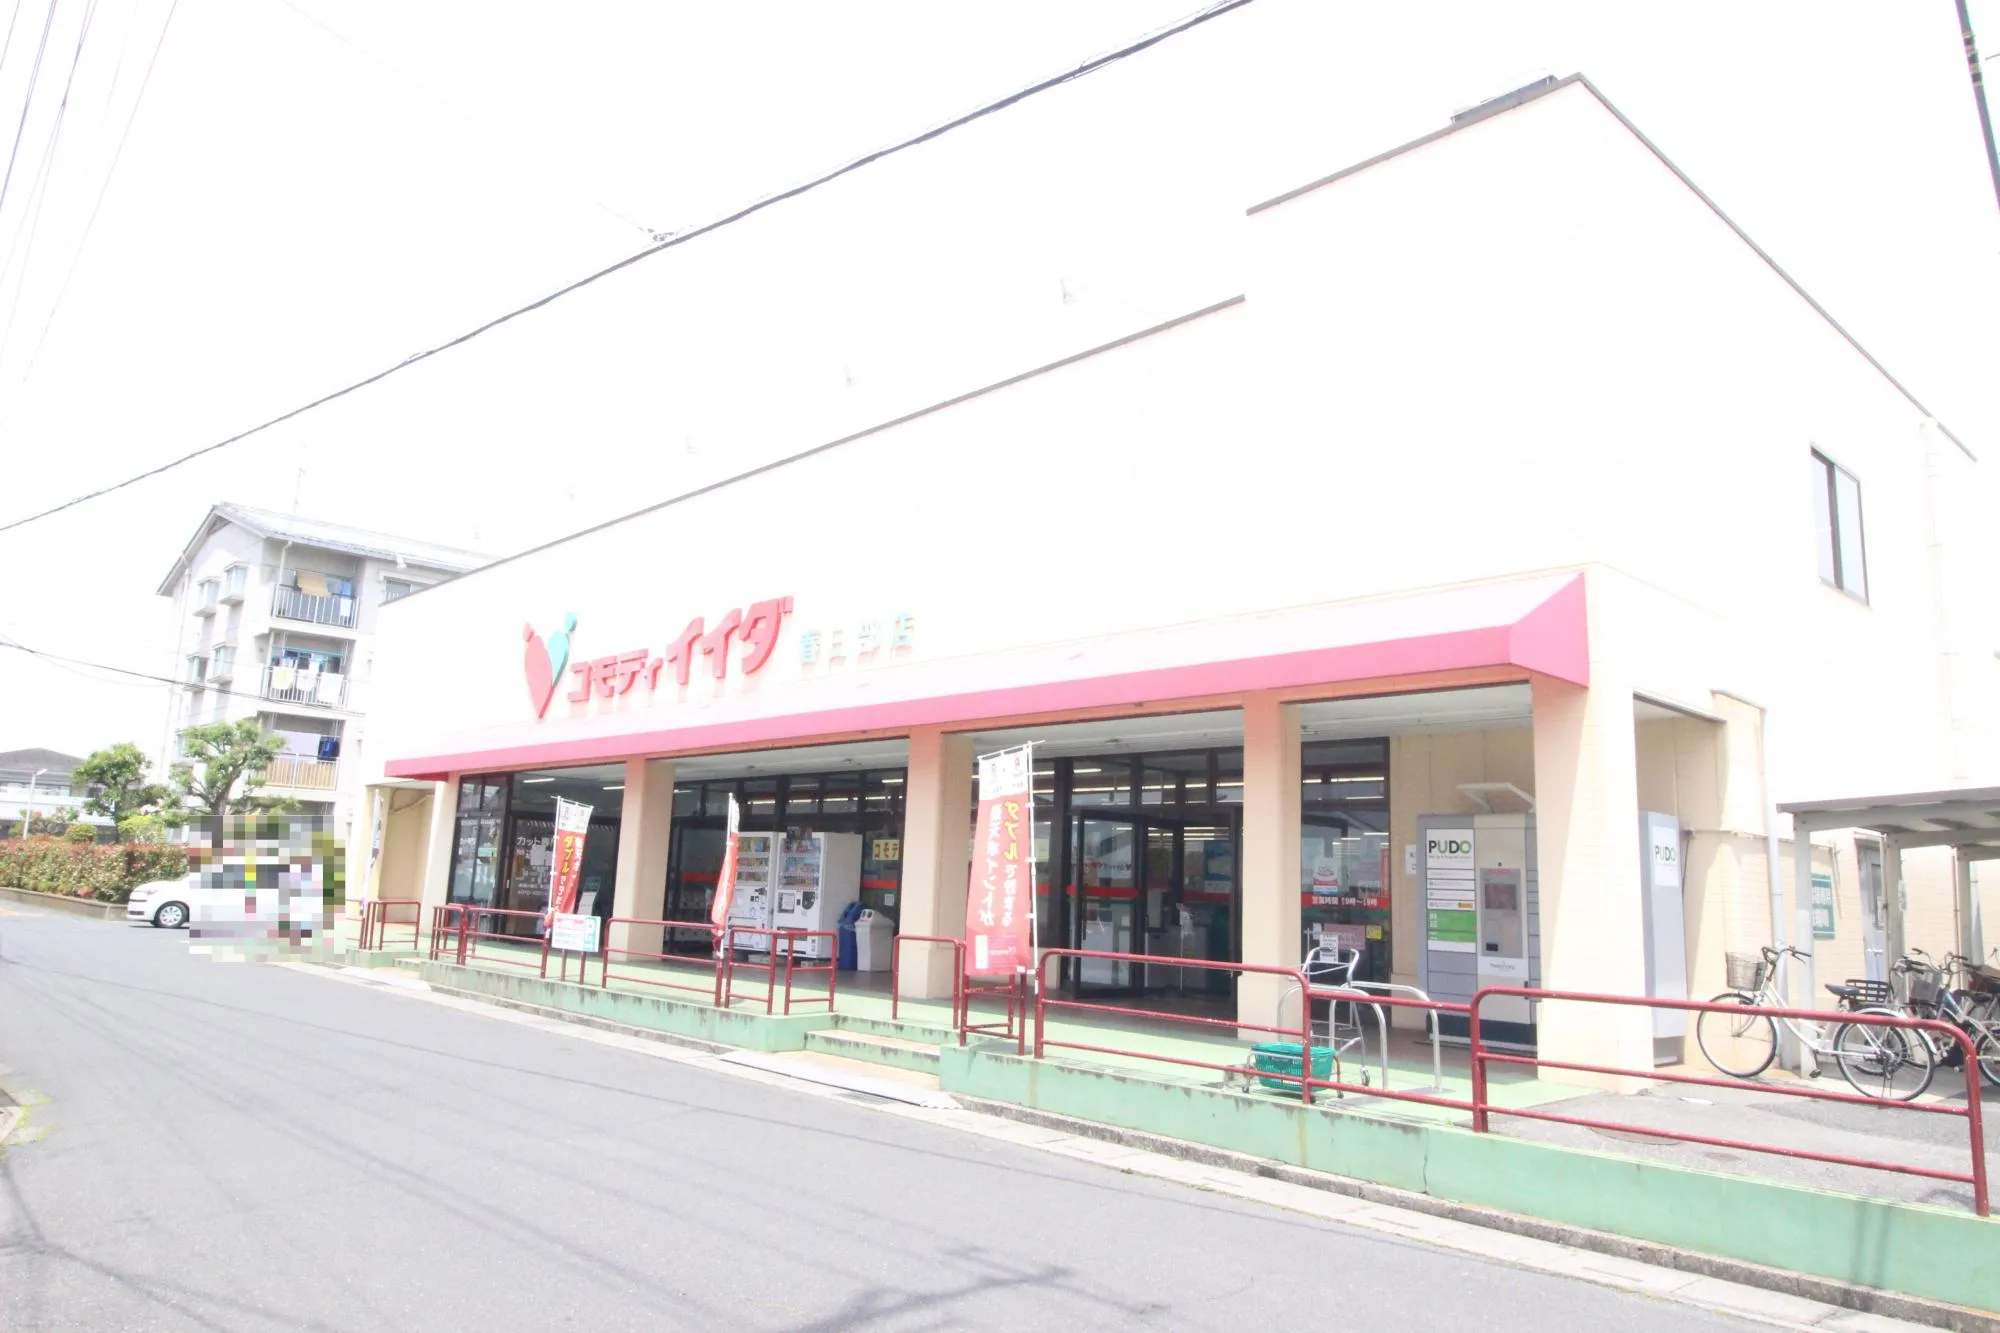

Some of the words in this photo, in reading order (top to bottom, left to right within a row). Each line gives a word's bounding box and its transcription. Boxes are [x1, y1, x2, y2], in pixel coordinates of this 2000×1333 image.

[567, 596, 794, 702] コモディイイダ
[1428, 840, 1472, 854] PUDO
[1655, 844, 1677, 861] PUDO
